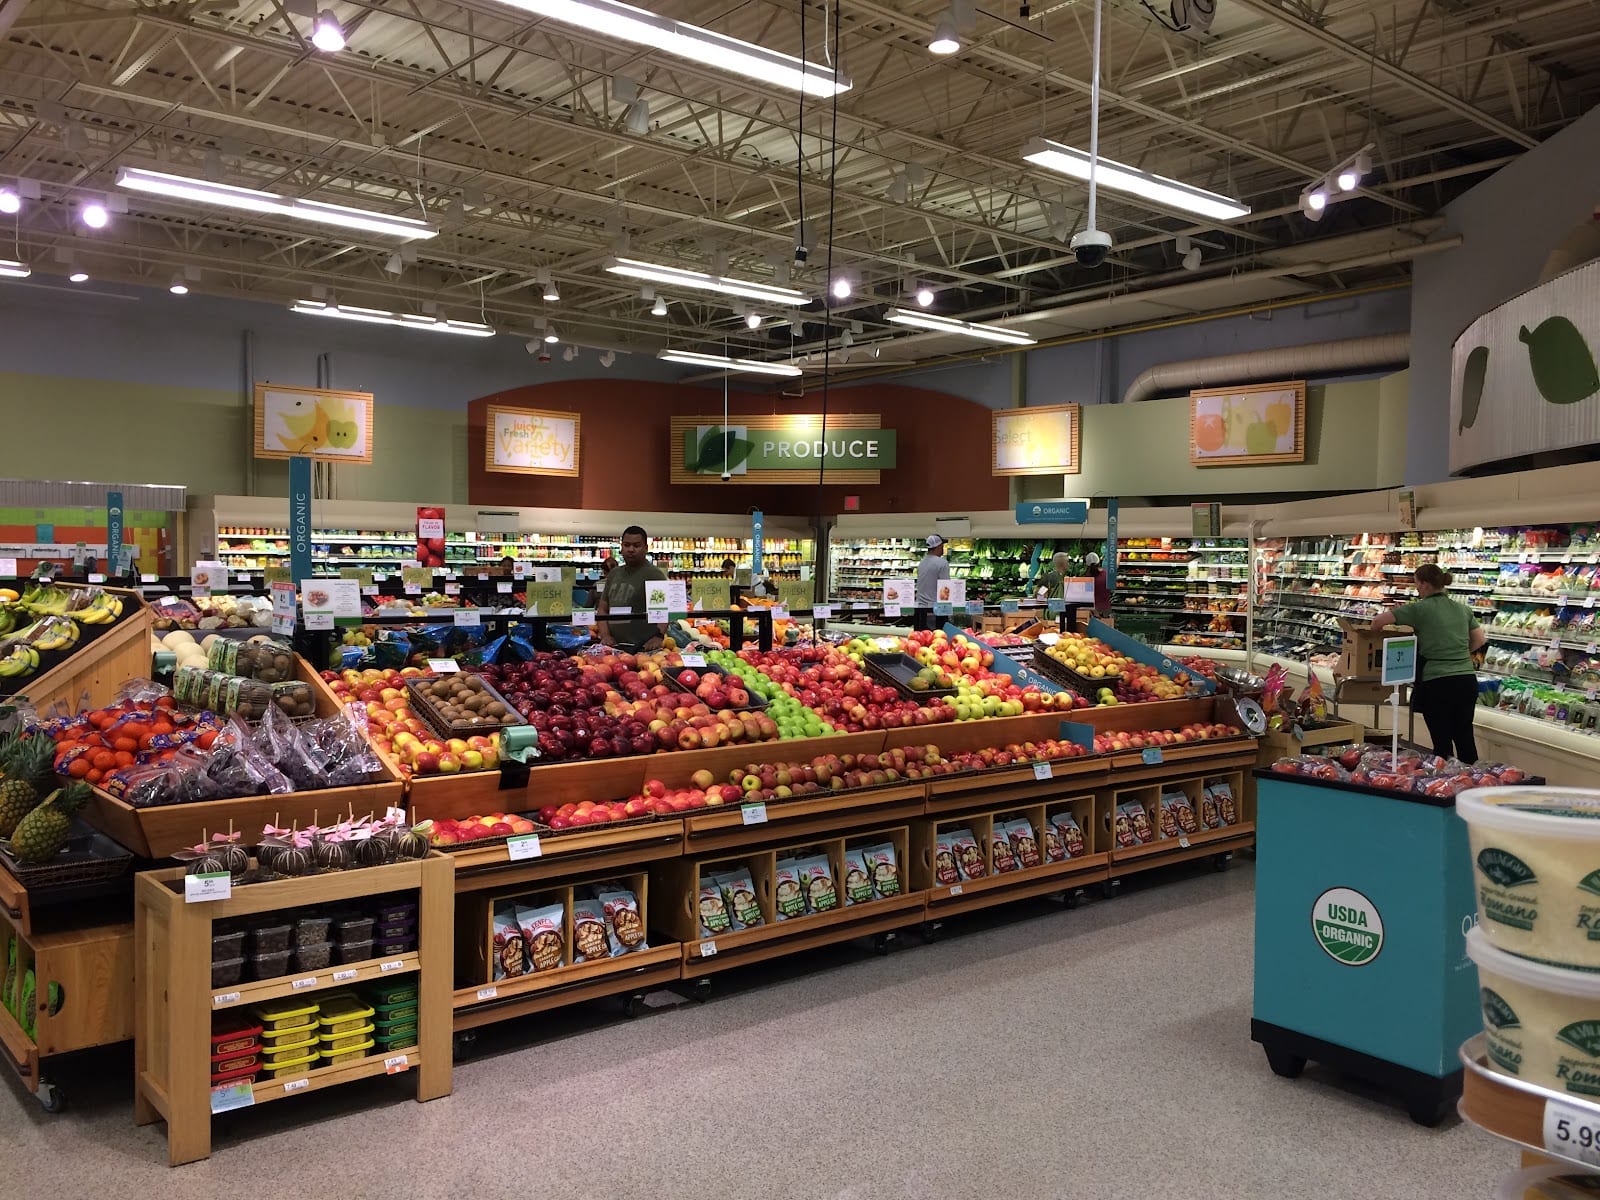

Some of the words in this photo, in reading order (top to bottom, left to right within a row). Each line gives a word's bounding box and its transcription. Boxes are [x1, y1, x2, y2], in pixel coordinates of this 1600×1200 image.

[503, 428, 529, 439] Fresh
[499, 431, 571, 463] Variety
[763, 440, 879, 458] PRODUCE
[296, 492, 306, 553] ORGANIC
[111, 521, 120, 560] ORGANIC
[531, 589, 561, 599] FRESH
[696, 586, 722, 597] FRESH
[782, 587, 806, 597] FRESH
[1028, 676, 1057, 696] ORGANIC
[1328, 903, 1367, 927] USDA
[1322, 925, 1373, 949] ORGANIC
[586, 945, 601, 954] APPLE
[540, 958, 554, 969] APPLE
